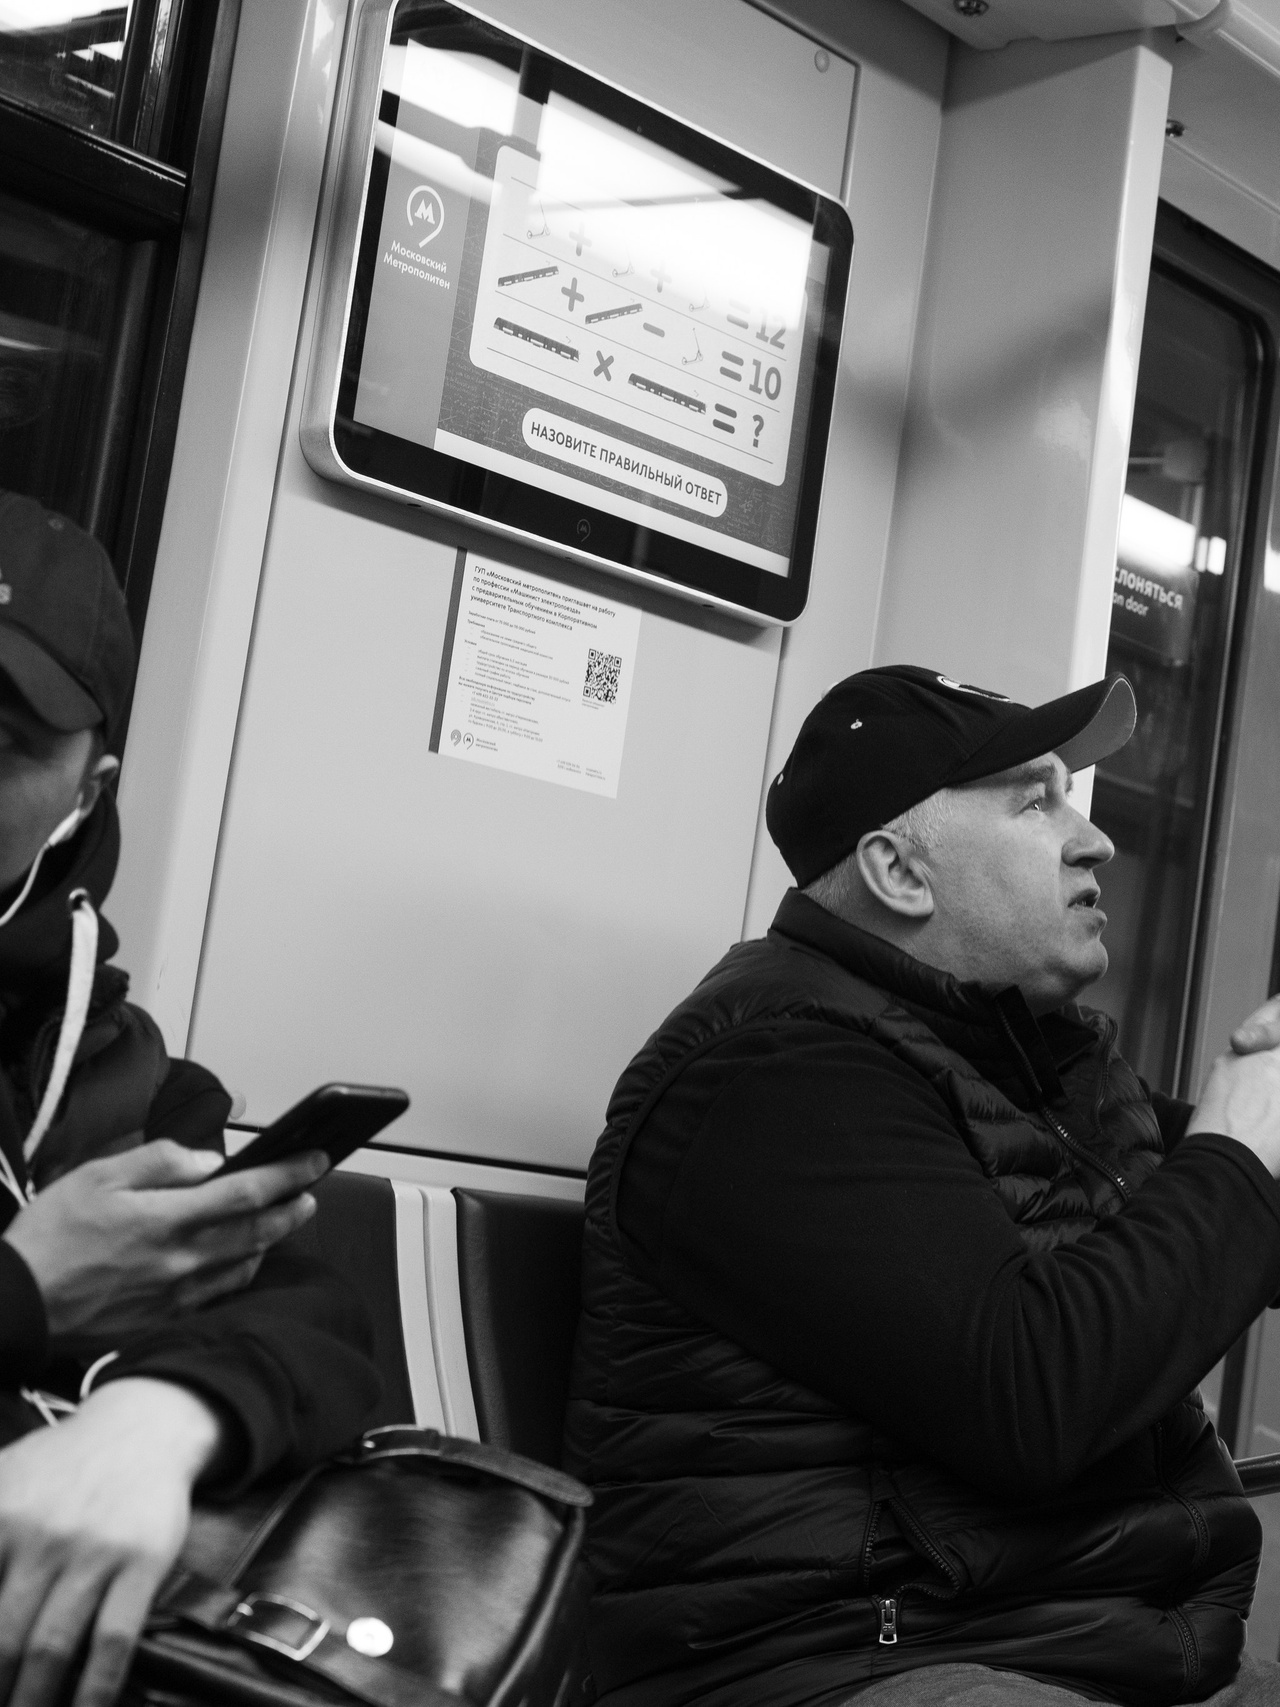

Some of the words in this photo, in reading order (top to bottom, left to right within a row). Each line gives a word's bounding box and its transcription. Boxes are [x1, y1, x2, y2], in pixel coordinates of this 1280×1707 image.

[383, 252, 451, 289] Метрополитен
[391, 240, 447, 273] Московский
[530, 421, 597, 458] НАЗОВИТЕ
[600, 448, 683, 491] ПРАВИЛЬНЫЙ
[685, 481, 722, 506] ОТВЕТ
[475, 566, 485, 575] ГУП
[598, 606, 616, 618] работу
[1125, 595, 1149, 617] door
